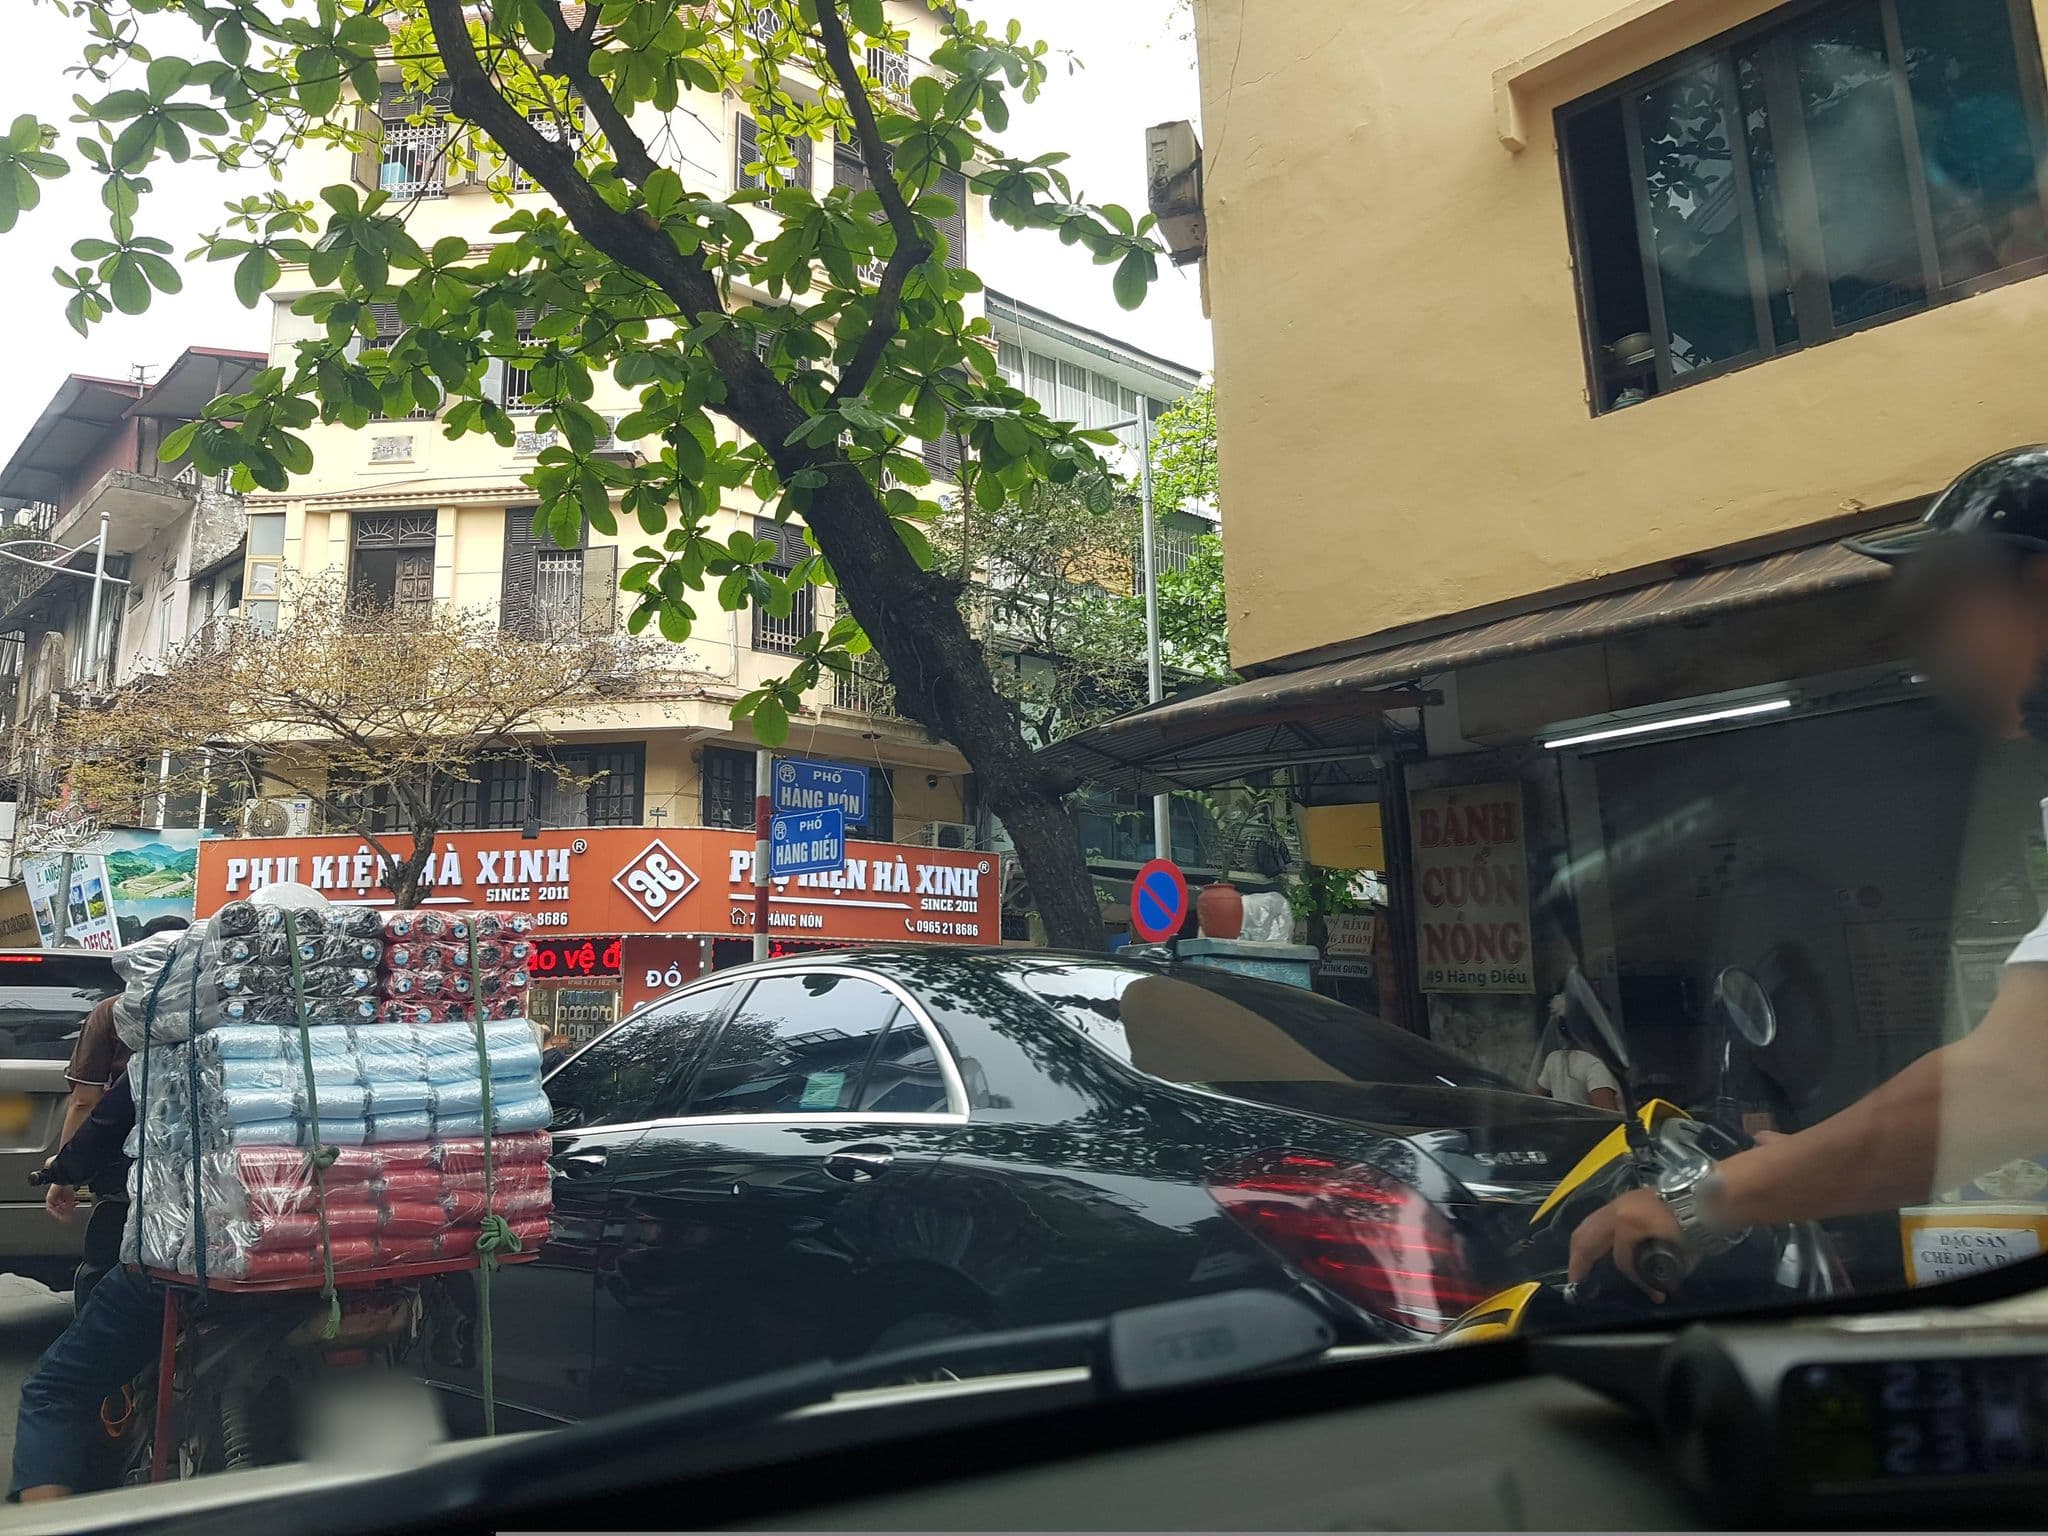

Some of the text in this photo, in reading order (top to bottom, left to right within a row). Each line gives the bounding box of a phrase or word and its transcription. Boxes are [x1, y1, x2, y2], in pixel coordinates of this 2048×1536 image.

[813, 766, 842, 783] PHỐ
[781, 783, 823, 809] HÀNG
[800, 814, 822, 831] PHỐ
[1420, 796, 1517, 848] BÁNH
[776, 832, 838, 865] HÀNG ĐIẾU
[476, 849, 571, 885] XINH
[872, 855, 911, 893] HÀ
[915, 864, 979, 898] XINH
[486, 887, 569, 902] SINCE 2011
[920, 898, 978, 912] SINCE 2011
[537, 913, 568, 926] 8686
[768, 910, 796, 927] HÀNG
[799, 912, 823, 928] NÓN
[916, 920, 978, 937] 0965 21 8686
[1424, 911, 1524, 964] NÓNG
[564, 942, 596, 974] vệ
[645, 961, 682, 988] ĐỒ
[1426, 966, 1527, 987] 49 Hàng Điếu
